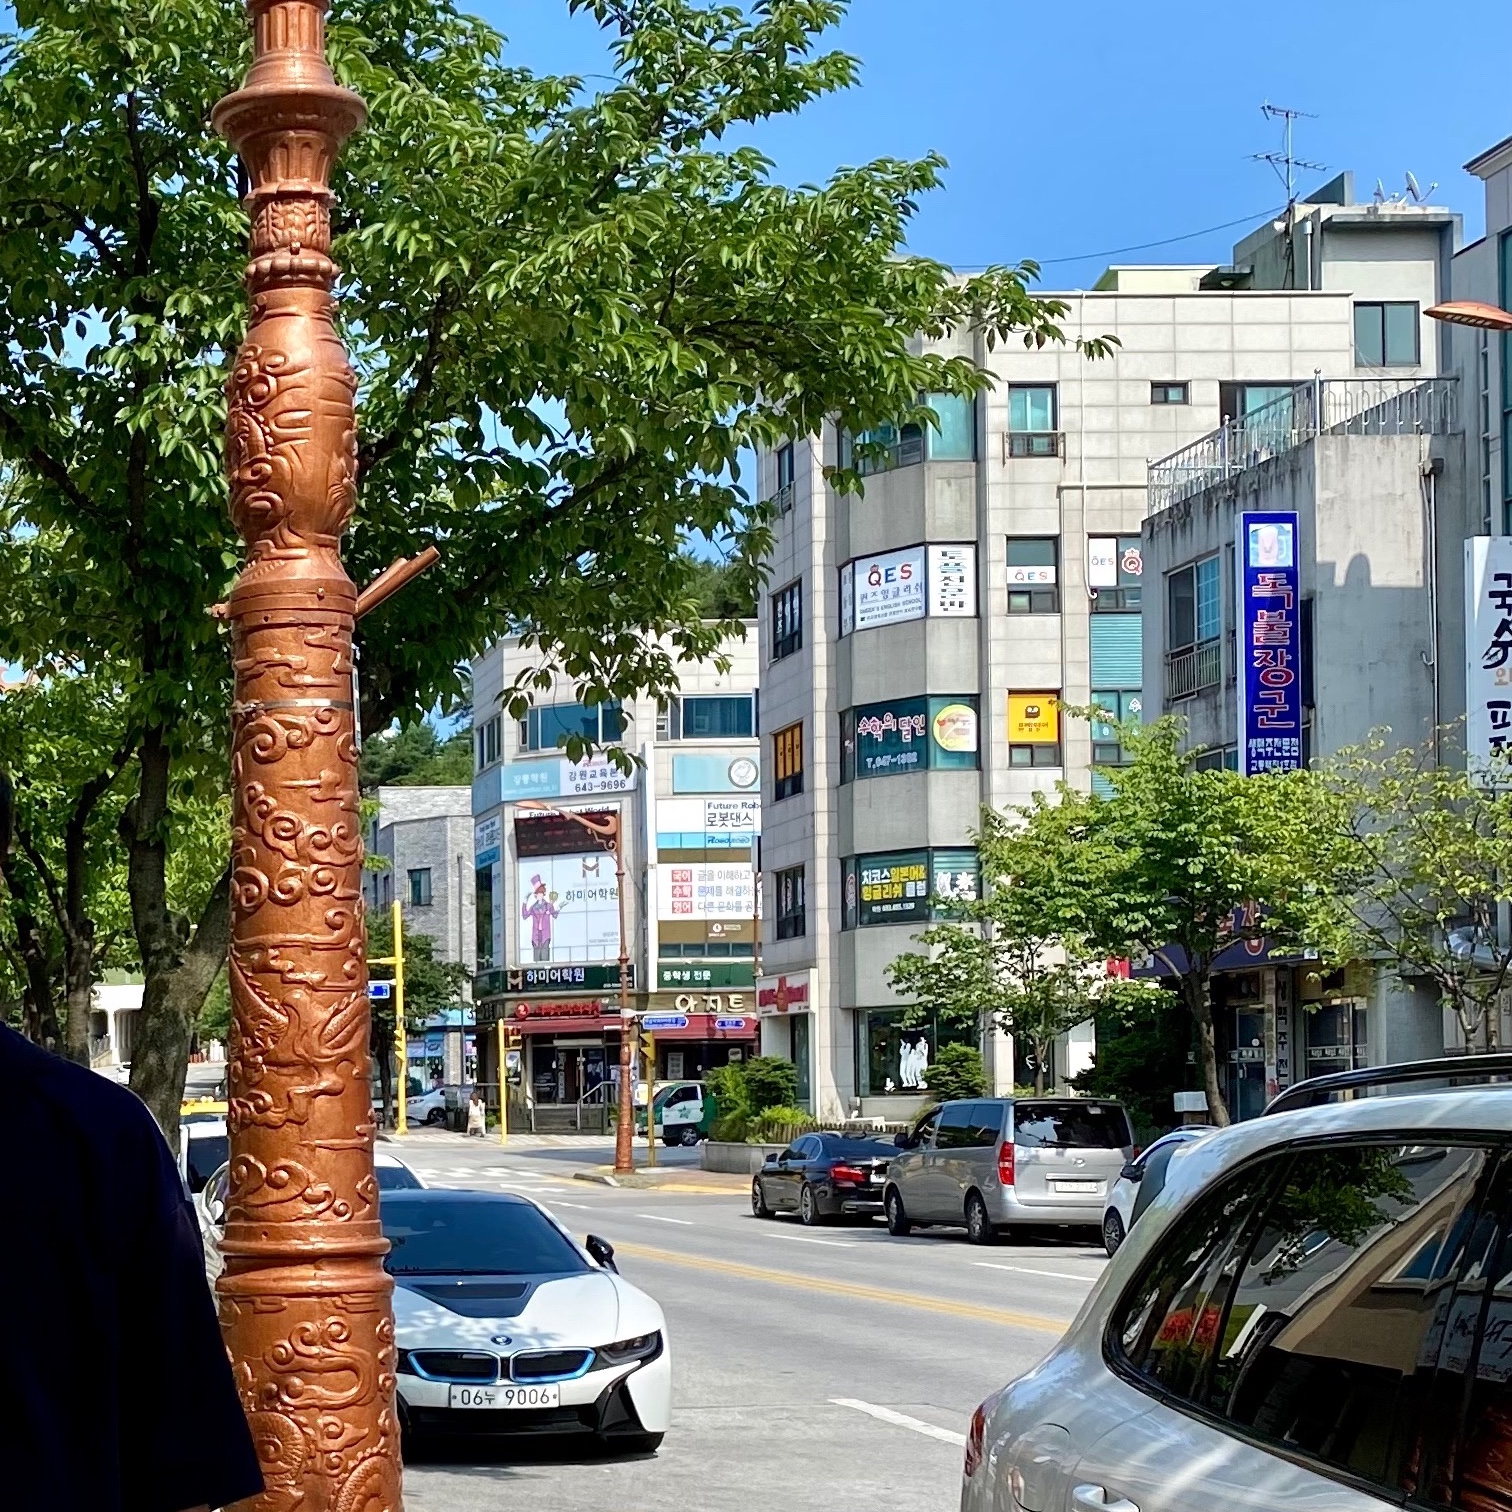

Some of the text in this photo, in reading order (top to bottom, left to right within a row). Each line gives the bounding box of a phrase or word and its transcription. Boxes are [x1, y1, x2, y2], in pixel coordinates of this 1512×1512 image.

[1091, 555, 1114, 566] QES
[868, 563, 913, 588] QES
[1014, 569, 1048, 582] QES
[1251, 573, 1296, 729] 독불장군
[857, 712, 897, 742] 수학의
[898, 714, 926, 743] 달인
[1248, 737, 1300, 758] 생맥주전문점
[574, 779, 627, 793] 643-9696
[707, 801, 739, 810] Future
[706, 811, 754, 828] 로봇댄스
[672, 870, 692, 882] 국어
[672, 885, 692, 898] 수학
[672, 901, 692, 914] 영어
[526, 967, 585, 984] 하미어학원
[674, 993, 746, 1013] 아지트
[461, 1387, 550, 1405] 06누 9006
